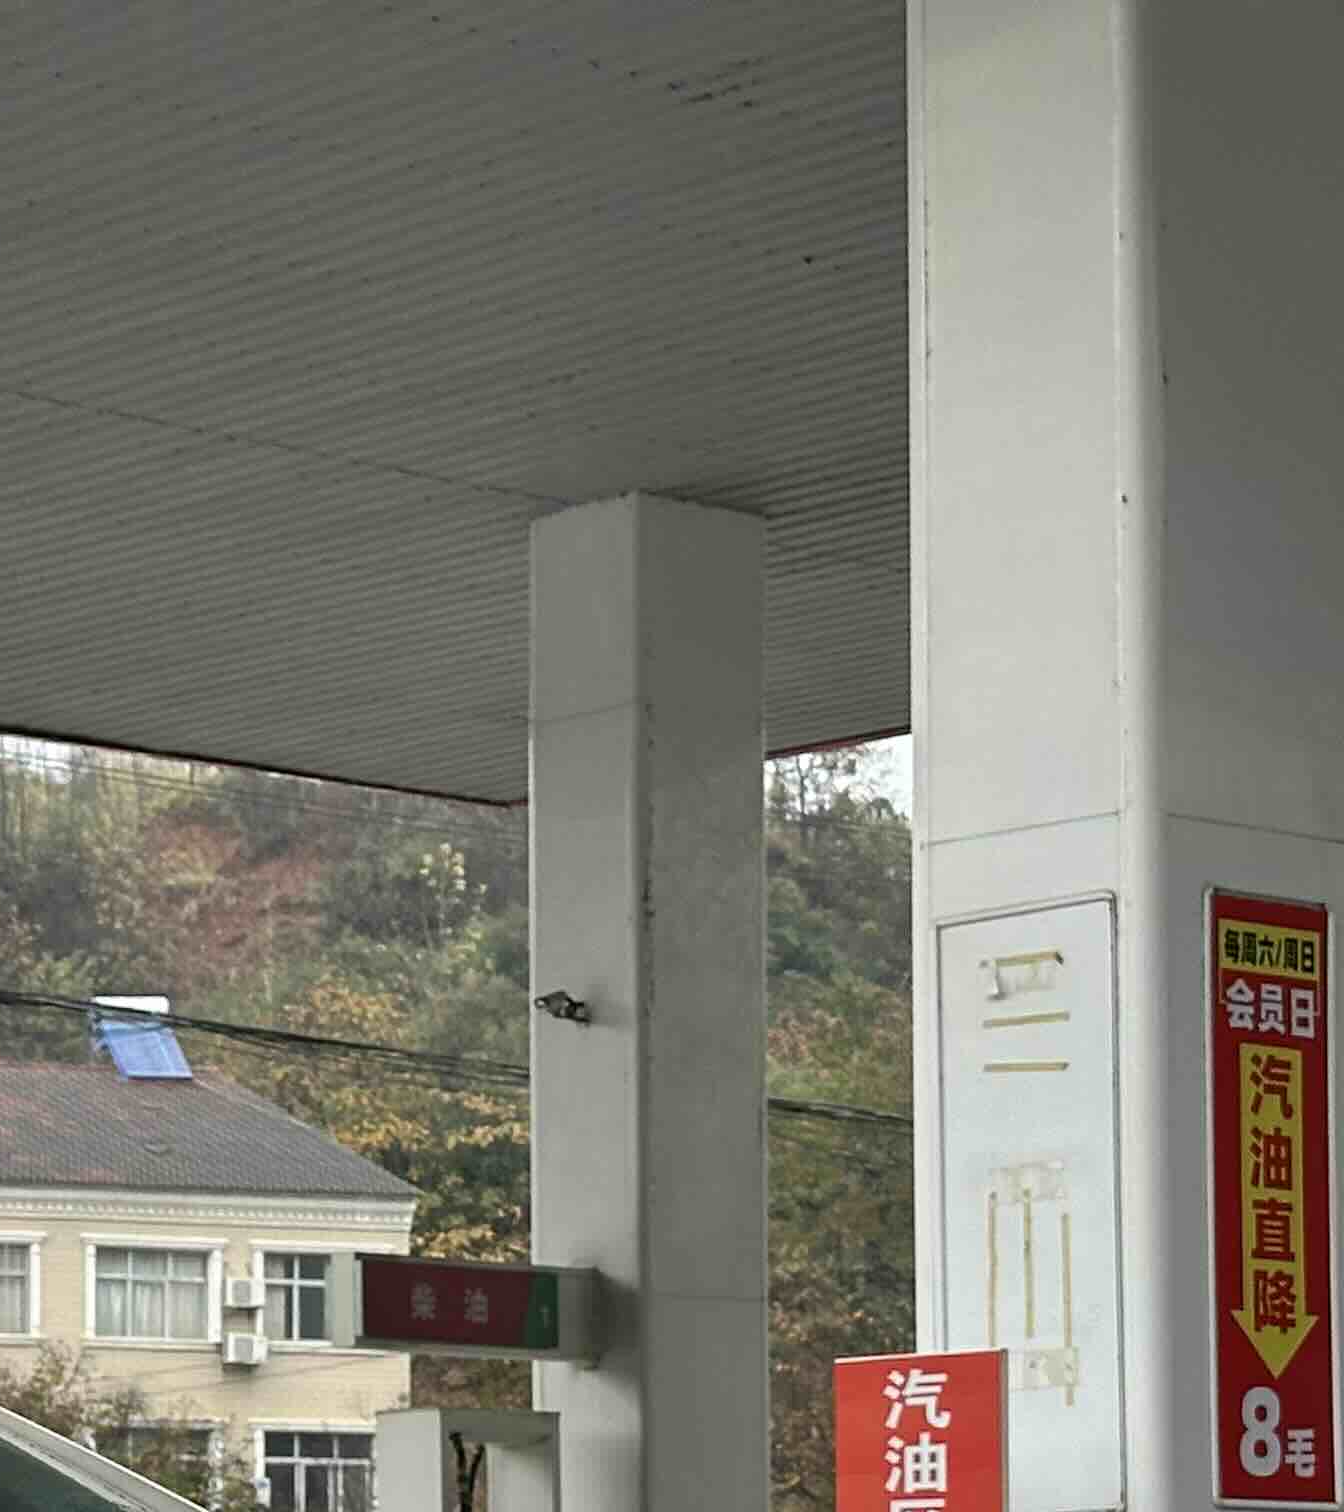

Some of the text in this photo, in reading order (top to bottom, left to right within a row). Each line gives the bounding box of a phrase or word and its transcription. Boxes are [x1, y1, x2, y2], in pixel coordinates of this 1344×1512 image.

[1224, 928, 1315, 975] 每周六/周日
[1226, 978, 1315, 1039] 会员日
[1249, 1053, 1298, 1335] 汽油直降
